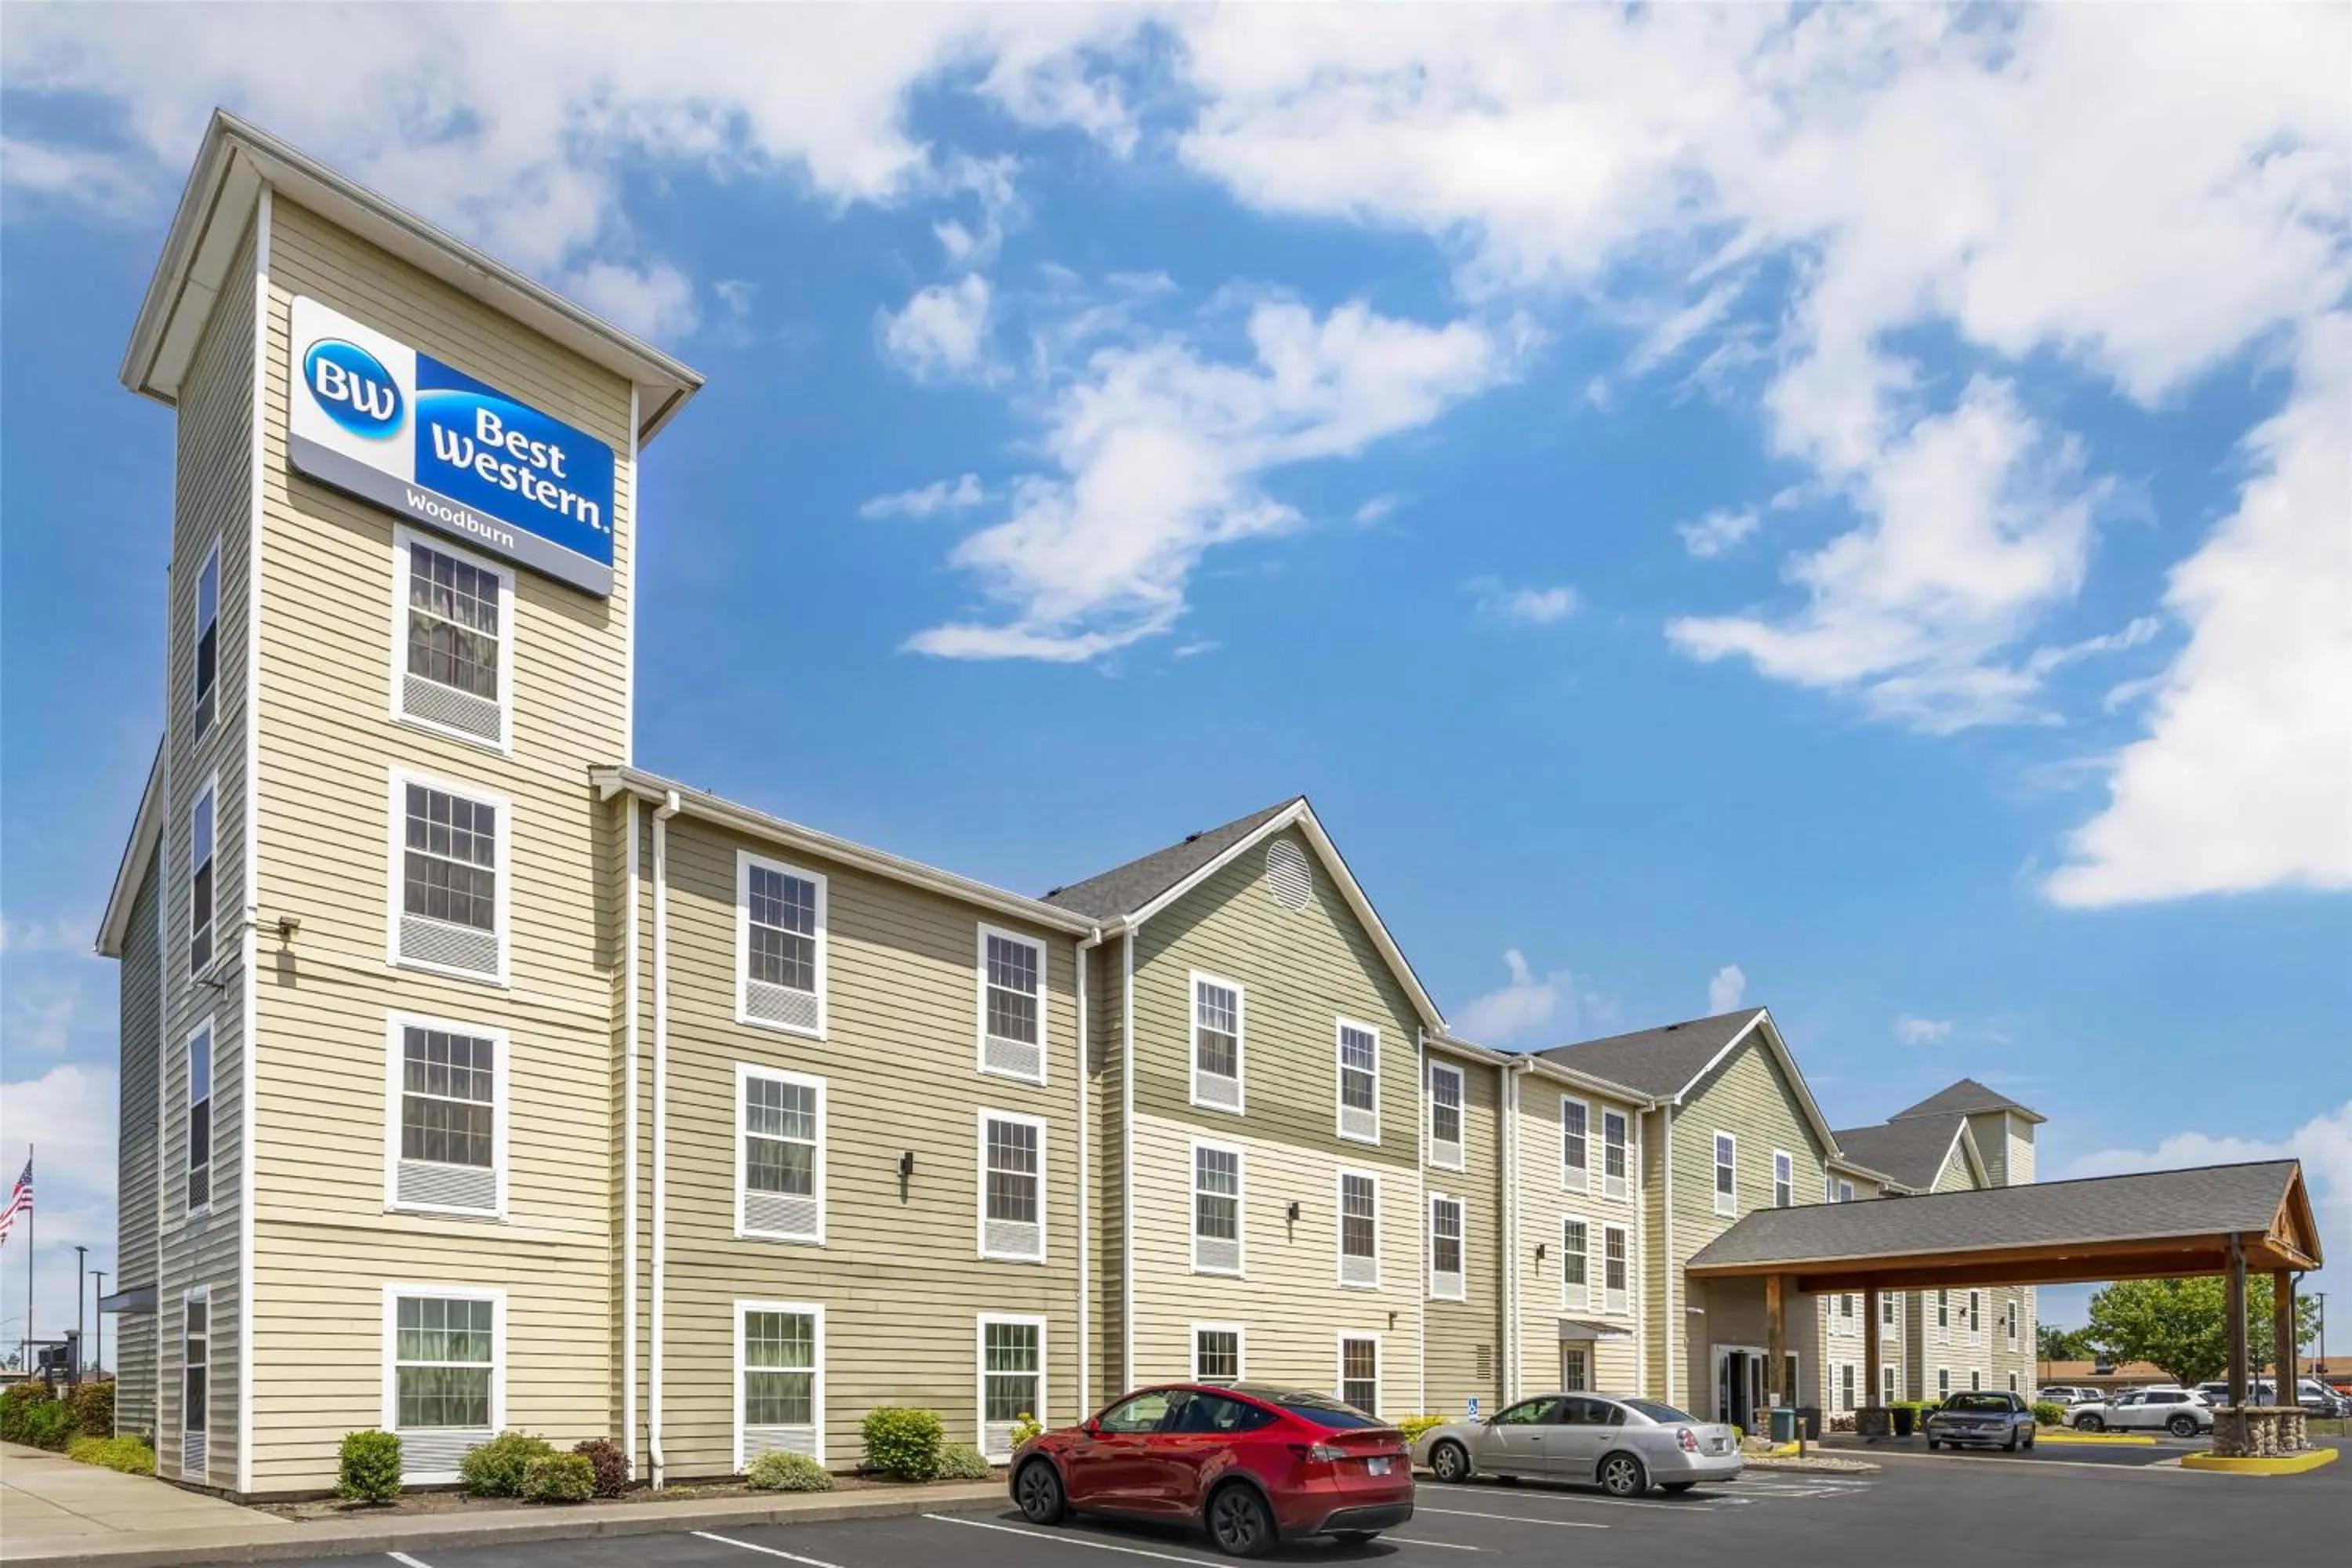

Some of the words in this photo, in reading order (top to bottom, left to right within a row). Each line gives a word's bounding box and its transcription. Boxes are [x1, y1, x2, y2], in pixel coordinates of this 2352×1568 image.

[316, 358, 394, 420] BW
[477, 407, 566, 478] Best
[406, 488, 514, 548] Woodburn
